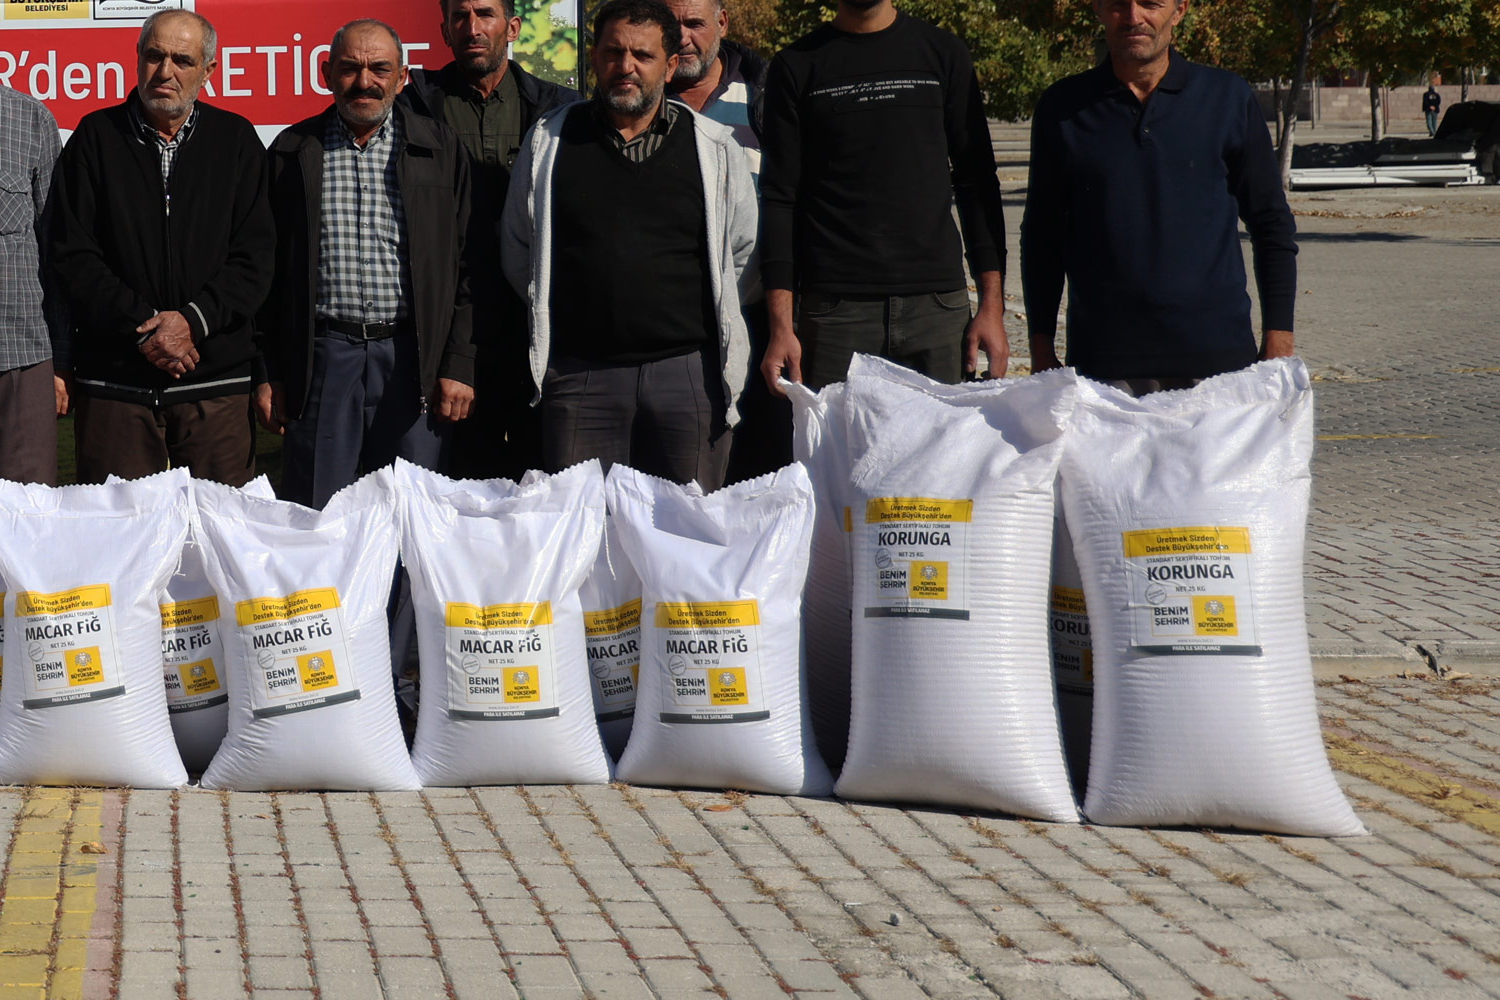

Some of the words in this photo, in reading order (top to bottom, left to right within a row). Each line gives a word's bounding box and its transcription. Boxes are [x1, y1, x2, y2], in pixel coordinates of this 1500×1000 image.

[902, 512, 952, 520] Büyükşehir'den
[878, 531, 951, 546] KORUNGA
[1157, 535, 1188, 543] Üretmek
[1189, 535, 1215, 543] Sizden
[1146, 544, 1170, 552] Destek
[1172, 543, 1228, 552] Büyükşehir'den
[1147, 564, 1234, 581] KORUNGA
[60, 594, 80, 603] Sizden
[172, 609, 192, 617] Sizden
[261, 602, 287, 611] Üretmek
[25, 624, 73, 641] MACAR
[253, 628, 304, 649] MACAR
[460, 640, 514, 654] MACAR
[588, 639, 638, 660] MACAR
[666, 639, 718, 654] MACAR
